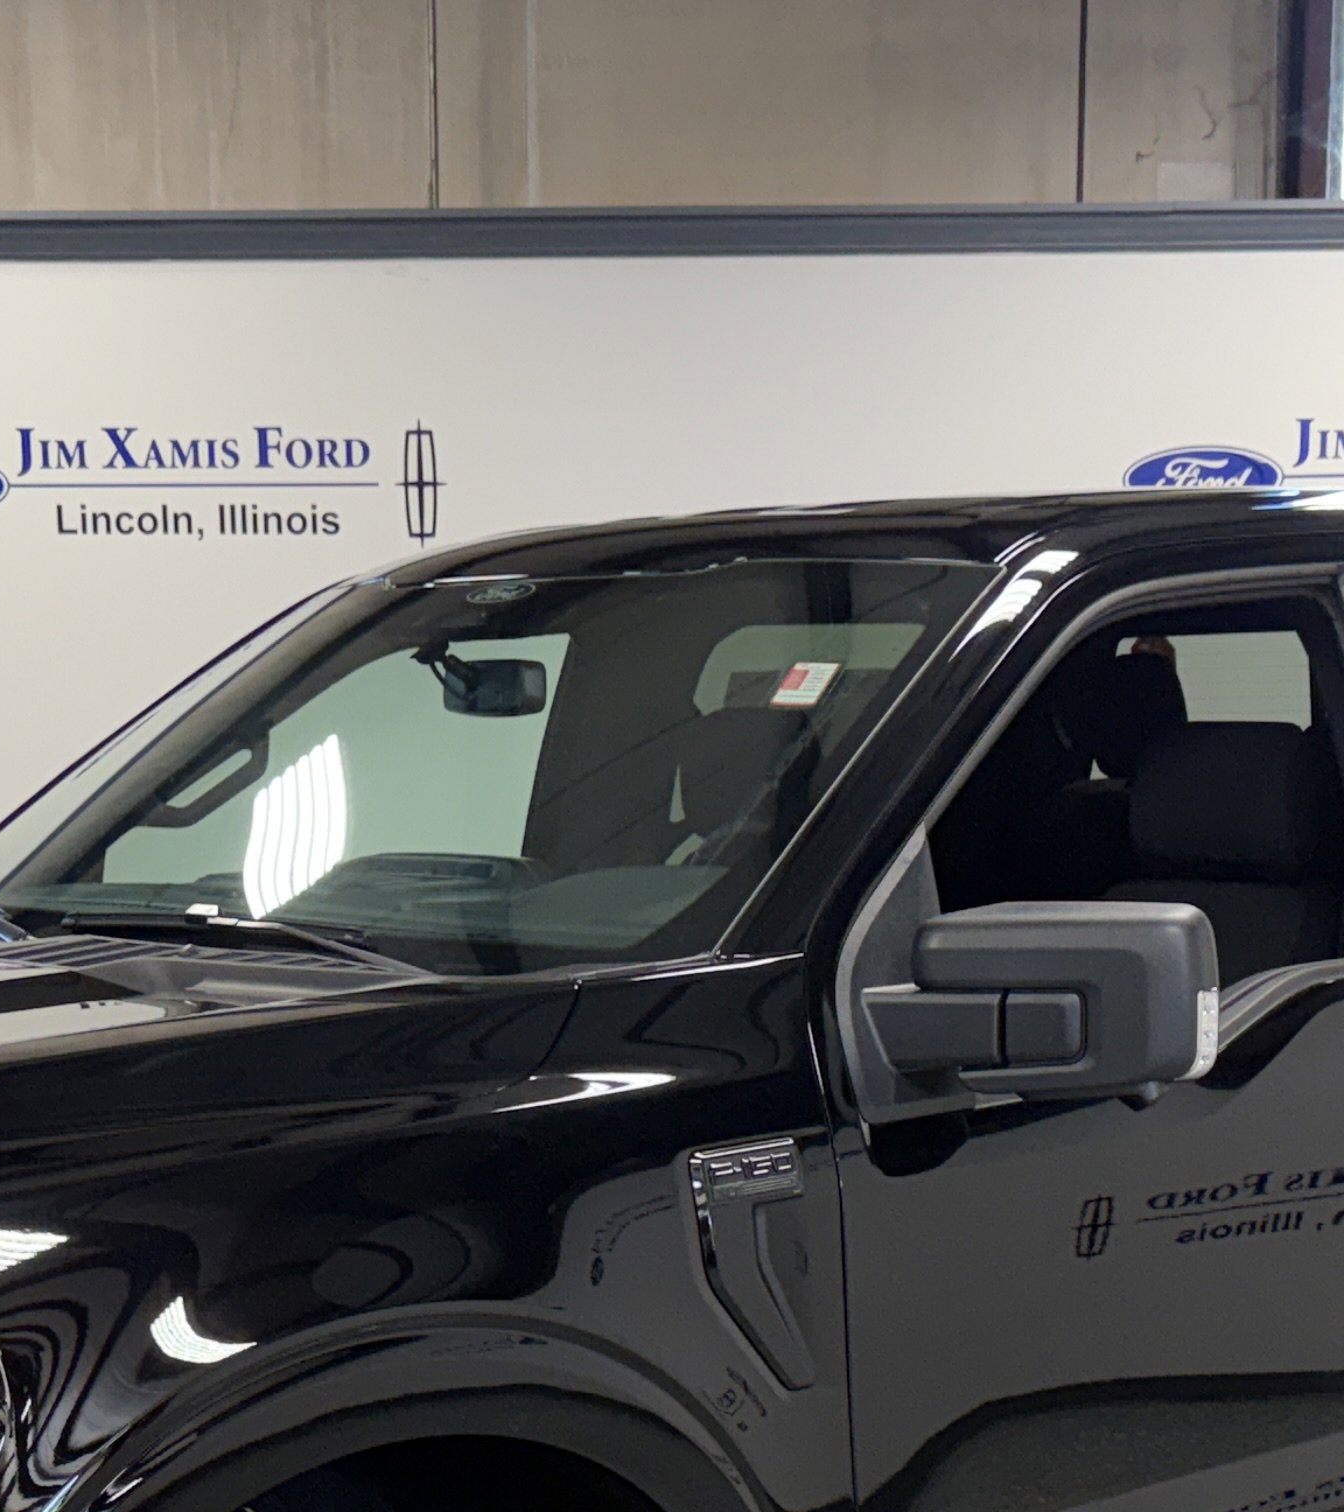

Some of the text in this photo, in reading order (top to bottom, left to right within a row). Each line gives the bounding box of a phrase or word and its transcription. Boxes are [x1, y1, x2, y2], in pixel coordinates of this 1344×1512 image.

[15, 426, 371, 477] JIM XAMIS FORD
[55, 503, 341, 541] Lincoln, Illinois
